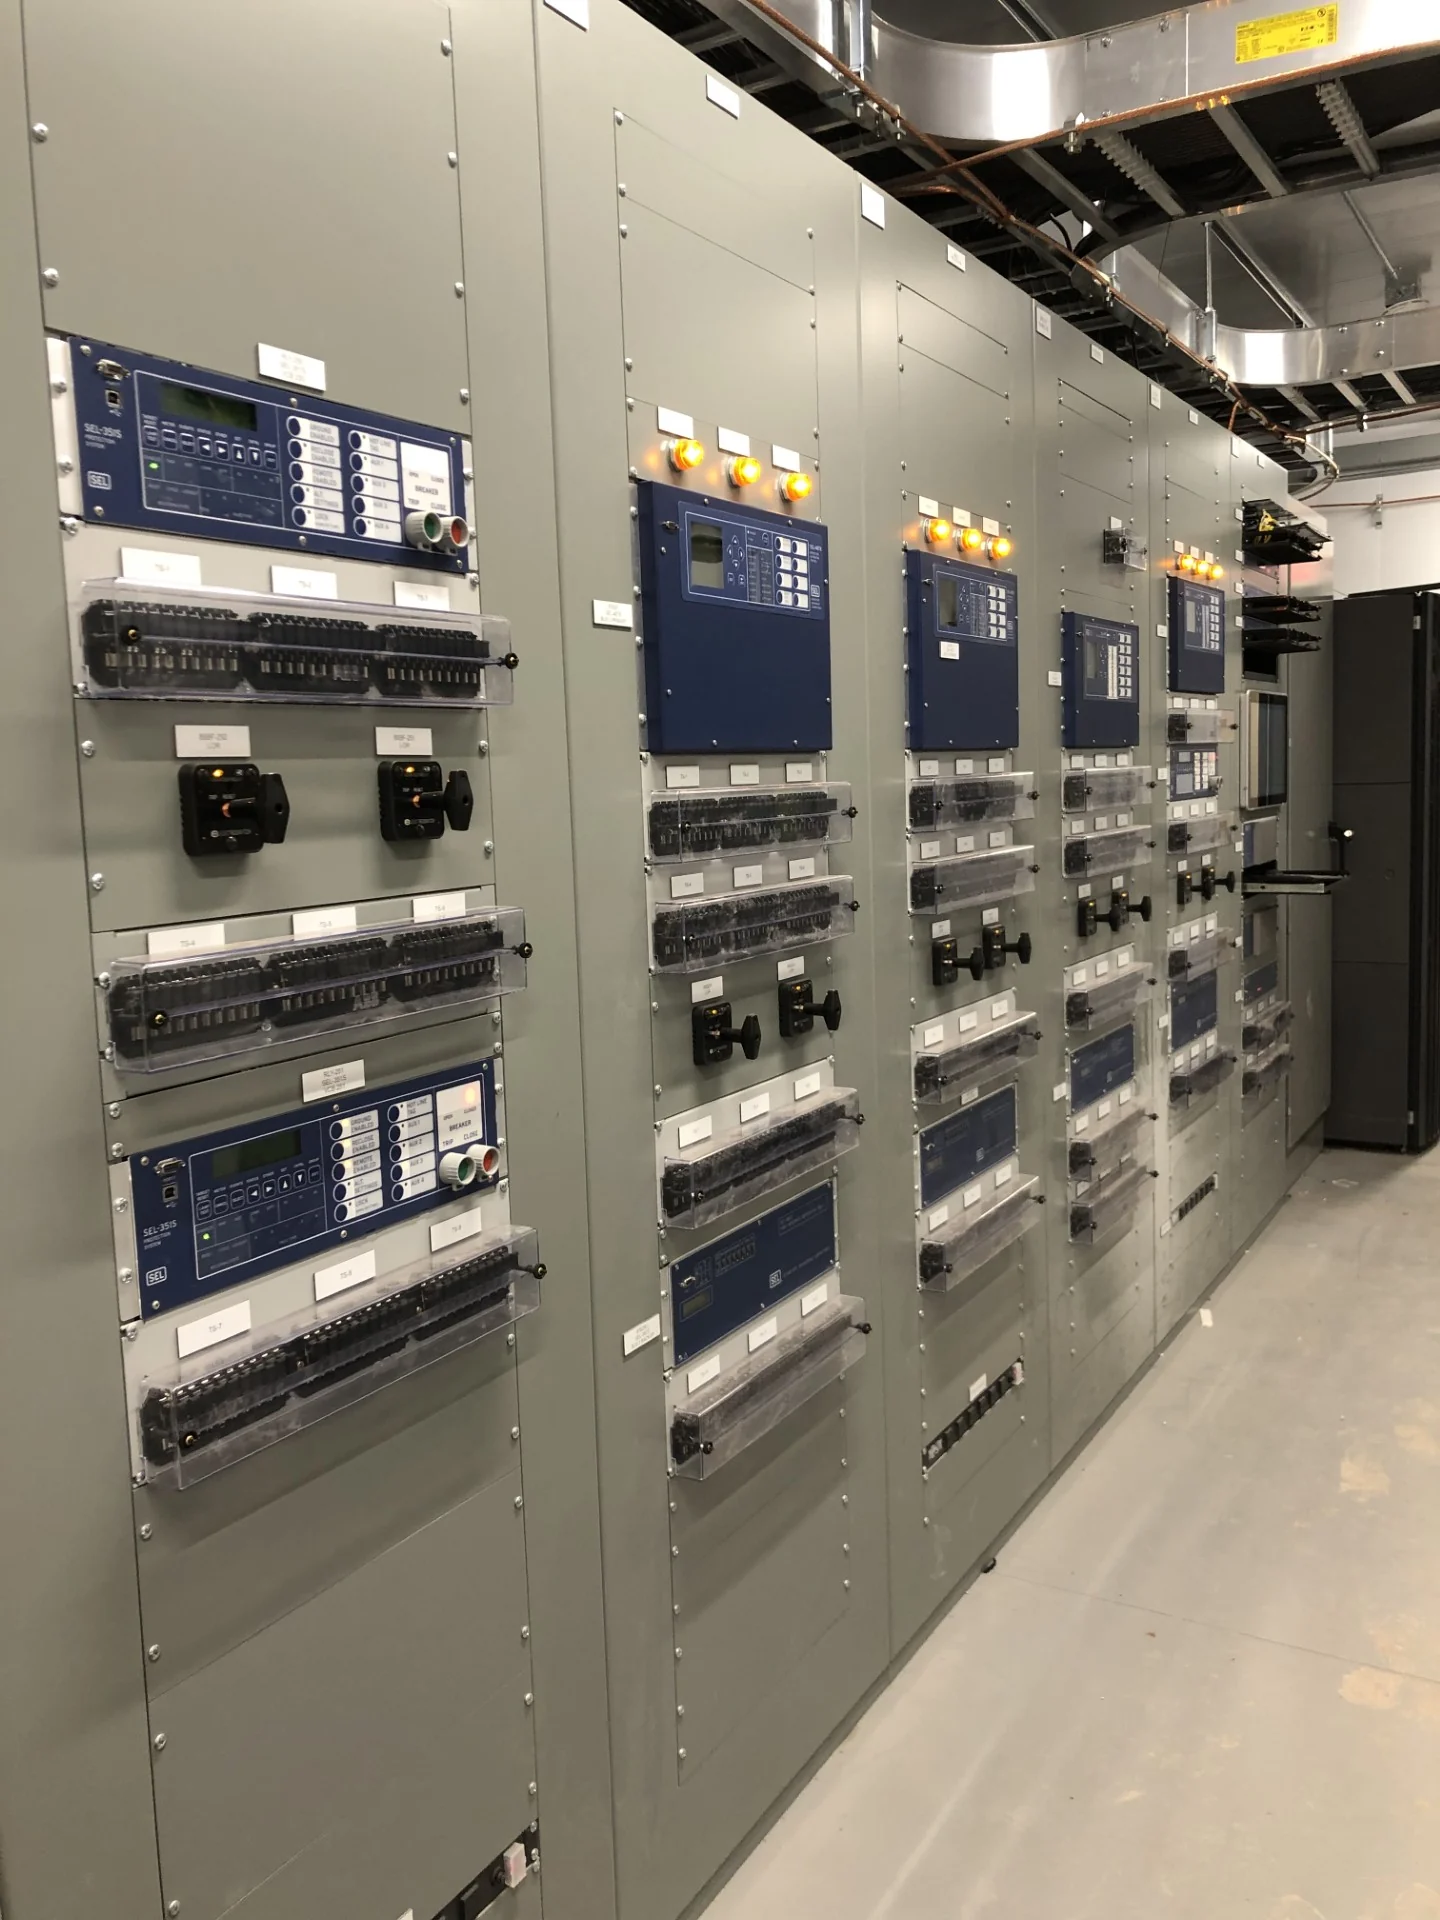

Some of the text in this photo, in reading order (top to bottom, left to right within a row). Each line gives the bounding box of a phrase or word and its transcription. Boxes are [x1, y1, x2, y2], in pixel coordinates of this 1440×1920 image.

[90, 474, 108, 486] SEL
[414, 484, 439, 496] BREAKER
[408, 498, 446, 512] TRIP CLOSE
[352, 1115, 372, 1126] GROUND
[449, 1120, 472, 1132] BREAKER
[352, 1122, 374, 1132] ENABLED
[352, 1134, 374, 1145] RECLOSE
[409, 1140, 418, 1148] AUX
[442, 1130, 478, 1147] TRIP CLOSE
[353, 1142, 376, 1154] ENABLED
[354, 1155, 372, 1166] REMOTE
[354, 1162, 376, 1174] ENABLED
[144, 1220, 177, 1237] SEL-351S
[148, 1270, 164, 1282] SEL
